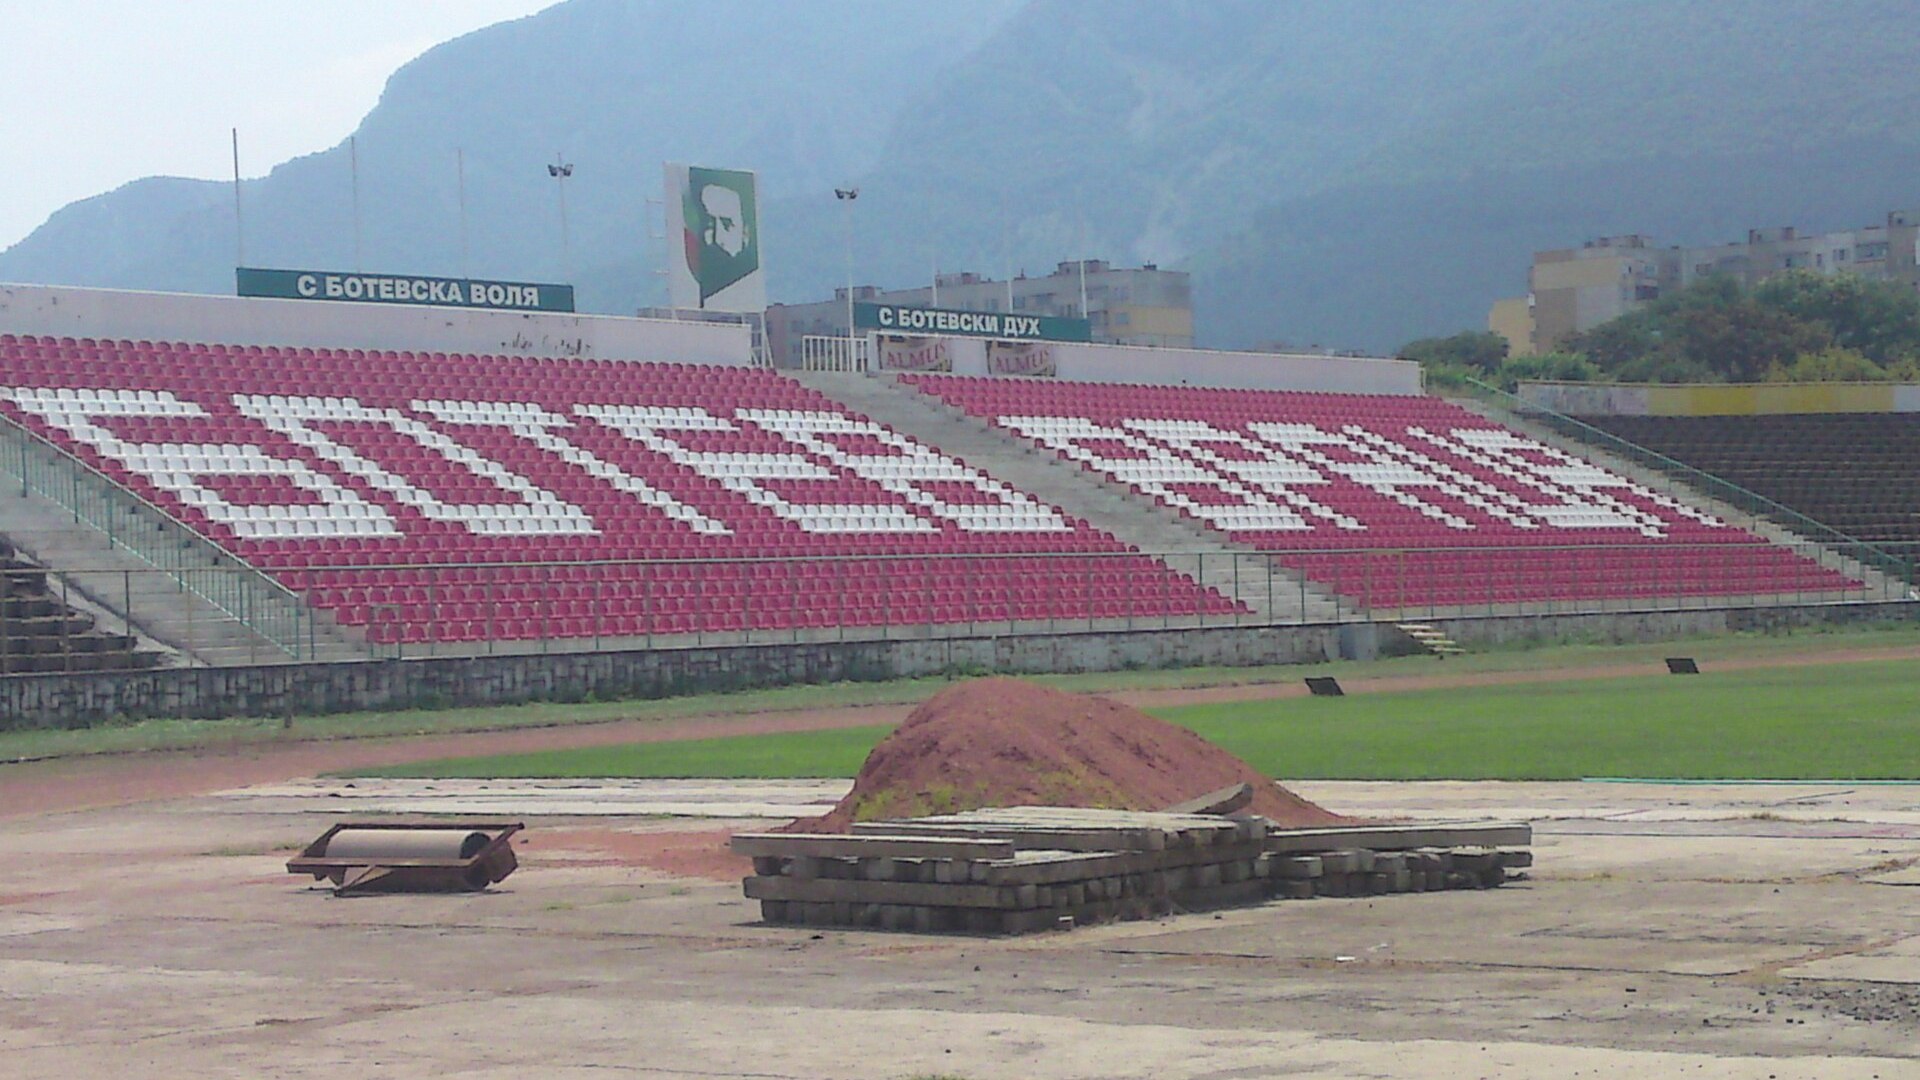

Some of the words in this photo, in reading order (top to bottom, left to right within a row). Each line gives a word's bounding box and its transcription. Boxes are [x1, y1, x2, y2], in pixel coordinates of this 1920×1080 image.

[297, 274, 317, 296] С
[325, 275, 463, 303] БОТЕВСКА
[470, 284, 540, 307] ВОЛЯ
[879, 307, 893, 326] С
[899, 310, 998, 332] БОТЕВСКИ
[1004, 317, 1040, 336] ДУХ
